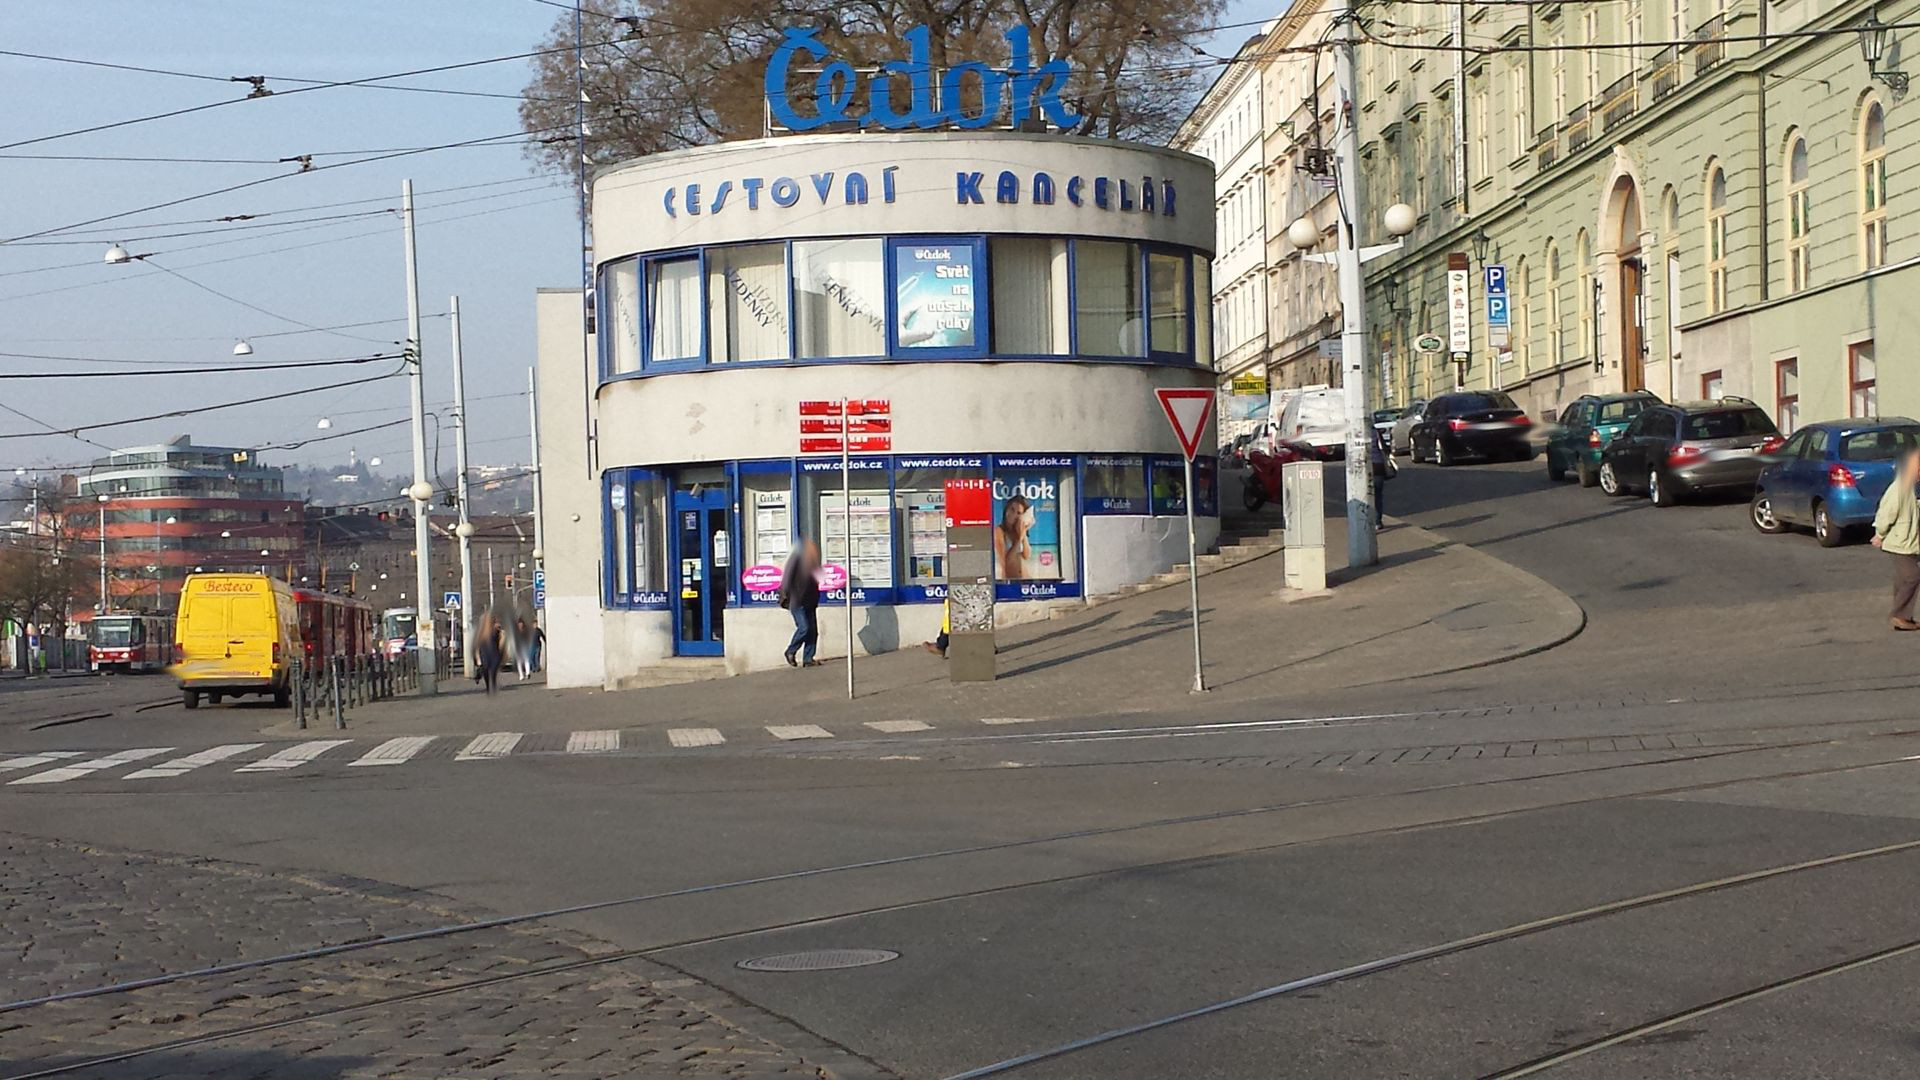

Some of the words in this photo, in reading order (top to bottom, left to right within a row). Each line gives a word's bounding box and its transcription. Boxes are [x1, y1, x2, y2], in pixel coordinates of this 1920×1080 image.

[663, 165, 900, 219] CESTOVNÍ
[936, 265, 970, 278] Svět
[1489, 268, 1502, 287] P
[952, 285, 969, 296] na
[901, 458, 982, 468] www.cedok.cz
[998, 456, 1072, 466] www.cedok.cz
[945, 517, 954, 528] 8
[204, 580, 253, 593] Besteco
